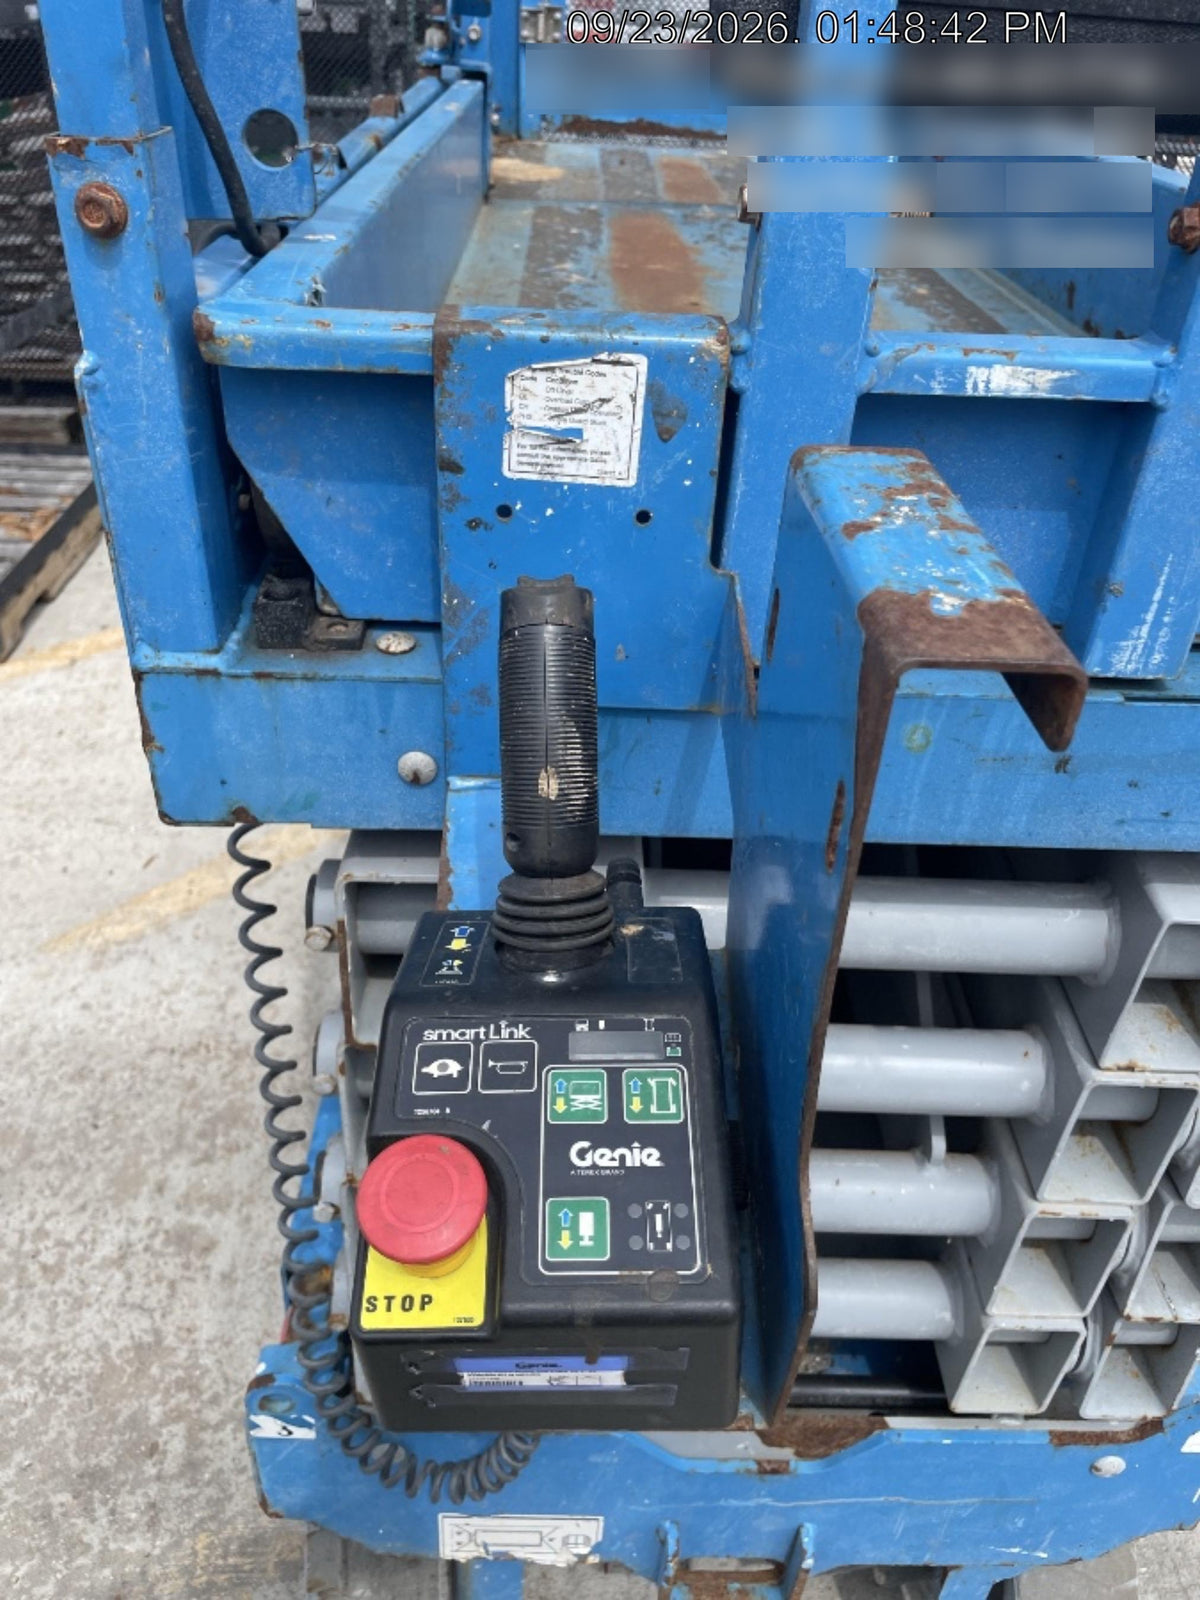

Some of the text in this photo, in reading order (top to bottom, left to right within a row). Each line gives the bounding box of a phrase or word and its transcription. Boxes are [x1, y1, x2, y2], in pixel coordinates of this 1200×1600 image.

[423, 1020, 532, 1040] smart Link
[569, 1140, 664, 1167] Genie
[365, 1293, 433, 1313] STOP
